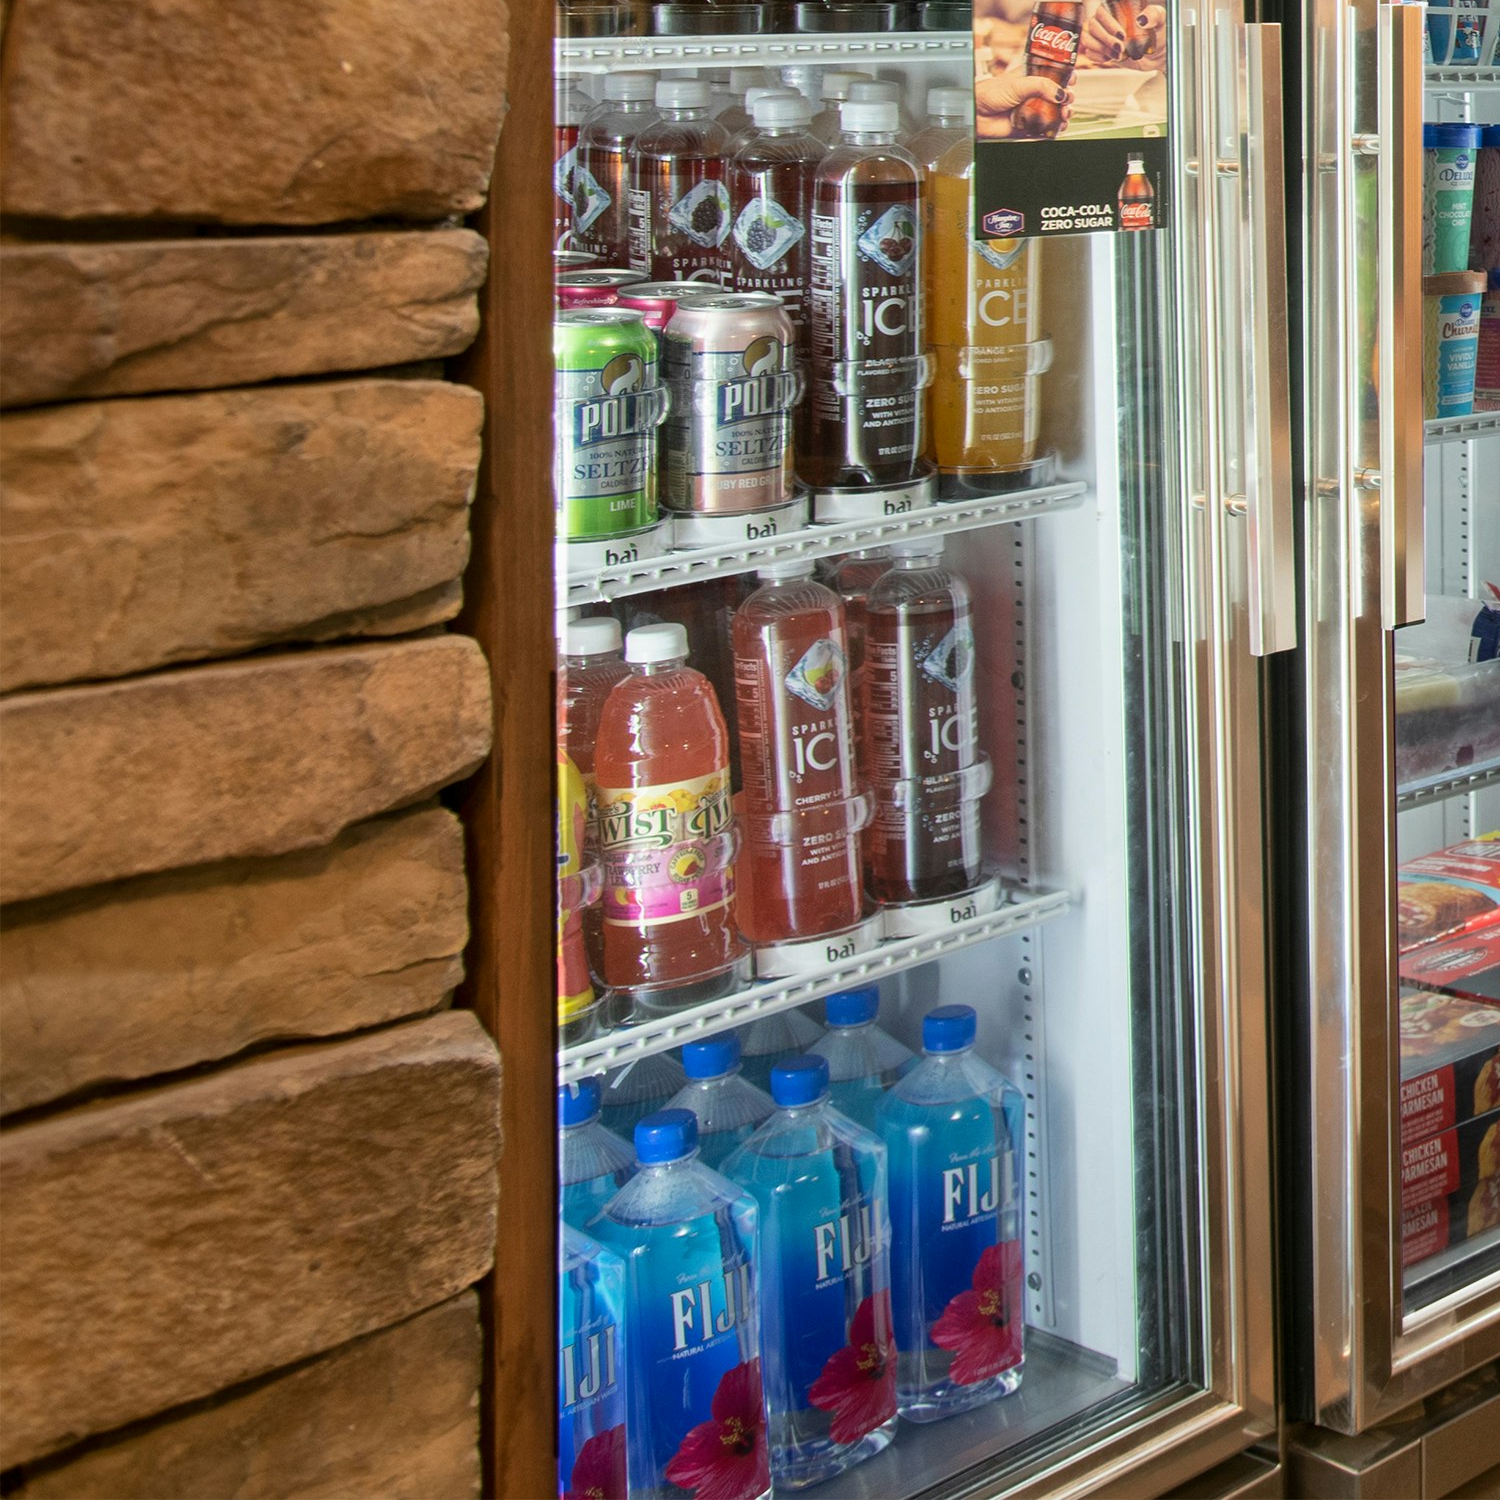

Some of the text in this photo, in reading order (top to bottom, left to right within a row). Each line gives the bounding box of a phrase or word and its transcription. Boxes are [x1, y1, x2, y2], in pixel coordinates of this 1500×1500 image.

[1040, 204, 1113, 219] COCA-COLA
[1040, 216, 1114, 231] ZERO SUGAR
[866, 397, 897, 409] ZERO
[609, 498, 636, 513] LIME
[746, 516, 778, 541] bai
[605, 543, 639, 568] bai
[795, 792, 832, 806] CHERRY
[802, 834, 834, 847] ZERO
[826, 938, 856, 963] bai
[942, 1149, 1017, 1225] FIJI
[814, 1199, 885, 1283] FIJI
[671, 1262, 751, 1352] FIJI
